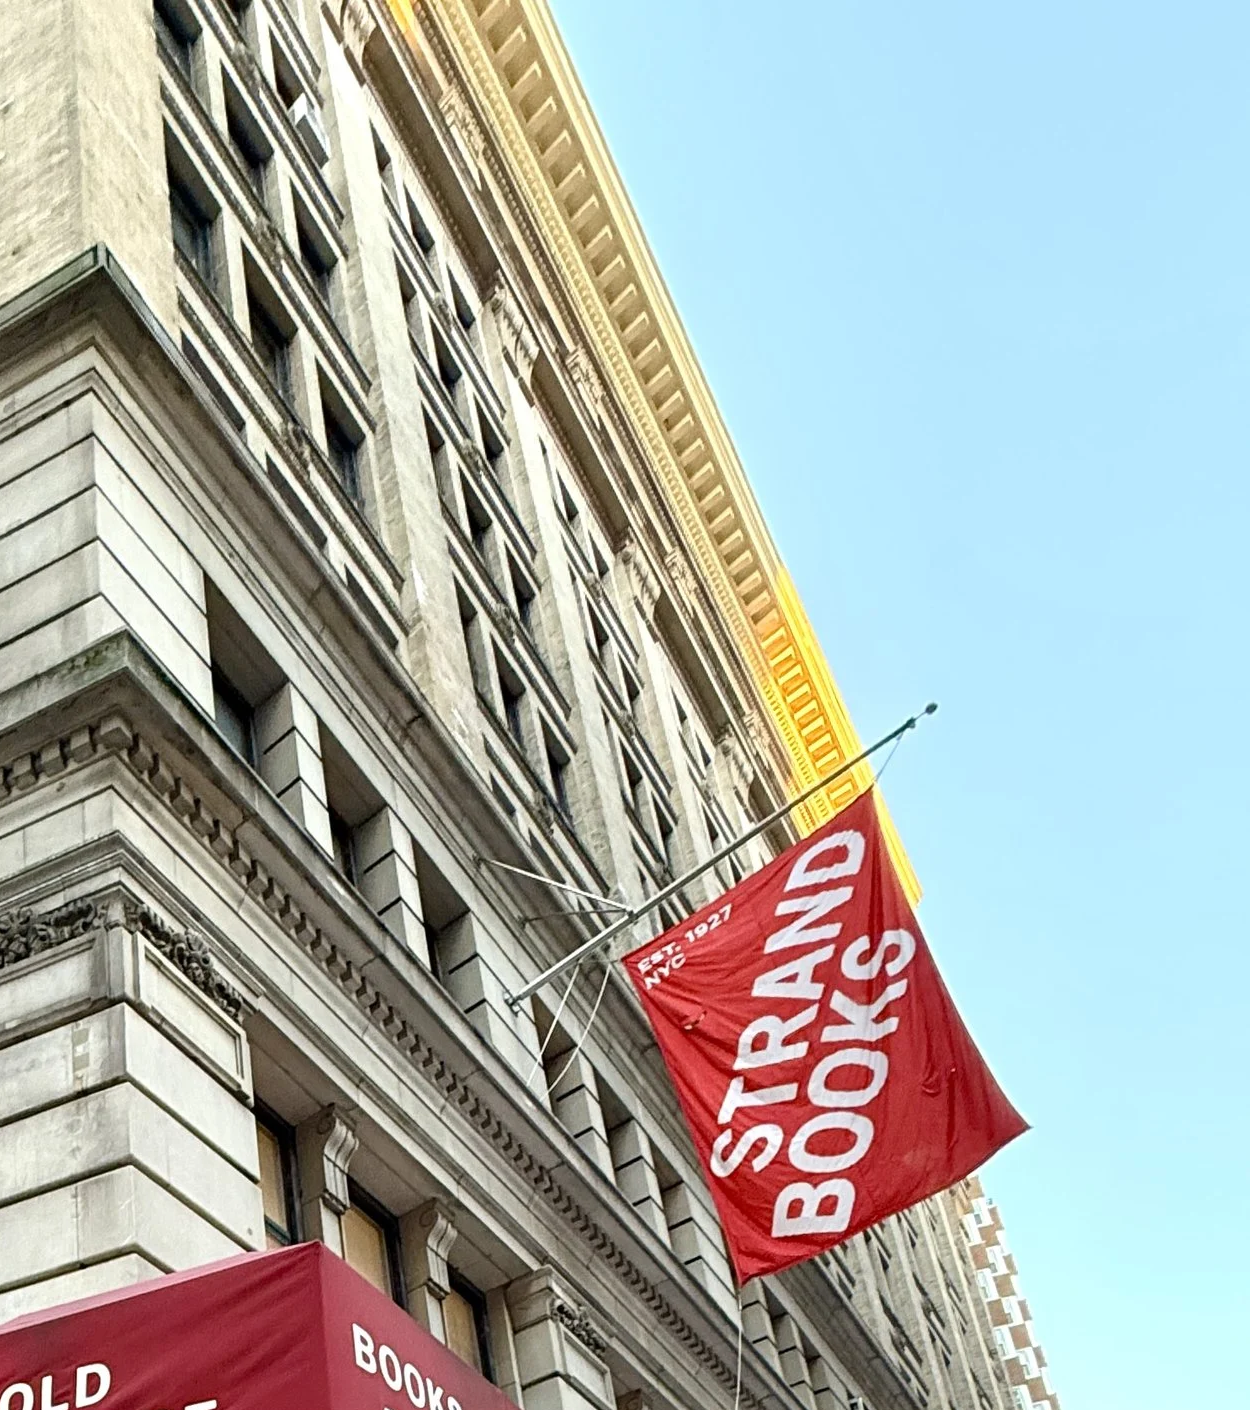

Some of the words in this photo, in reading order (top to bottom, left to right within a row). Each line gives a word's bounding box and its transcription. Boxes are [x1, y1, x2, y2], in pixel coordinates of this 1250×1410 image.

[637, 942, 683, 974] EST.
[685, 903, 733, 942] 1927
[644, 954, 688, 990] NYC
[710, 829, 866, 1179] STRAND
[771, 927, 916, 1238] BOOKS
